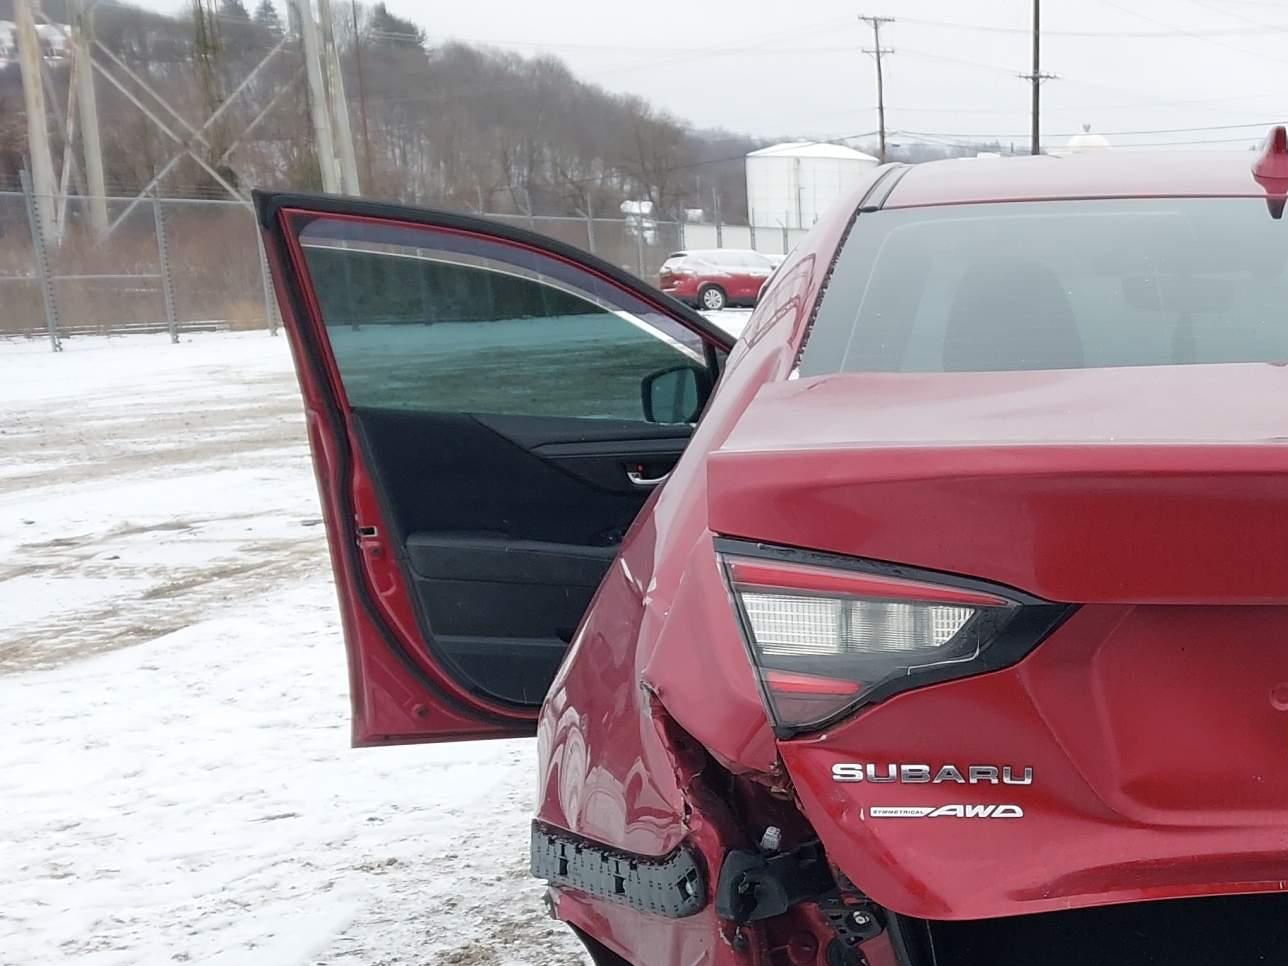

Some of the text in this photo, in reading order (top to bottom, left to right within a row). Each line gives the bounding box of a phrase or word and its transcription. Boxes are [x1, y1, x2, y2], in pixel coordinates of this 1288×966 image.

[831, 763, 1033, 785] SUBARU
[872, 804, 1024, 818] SYMMETRICAL AWD
